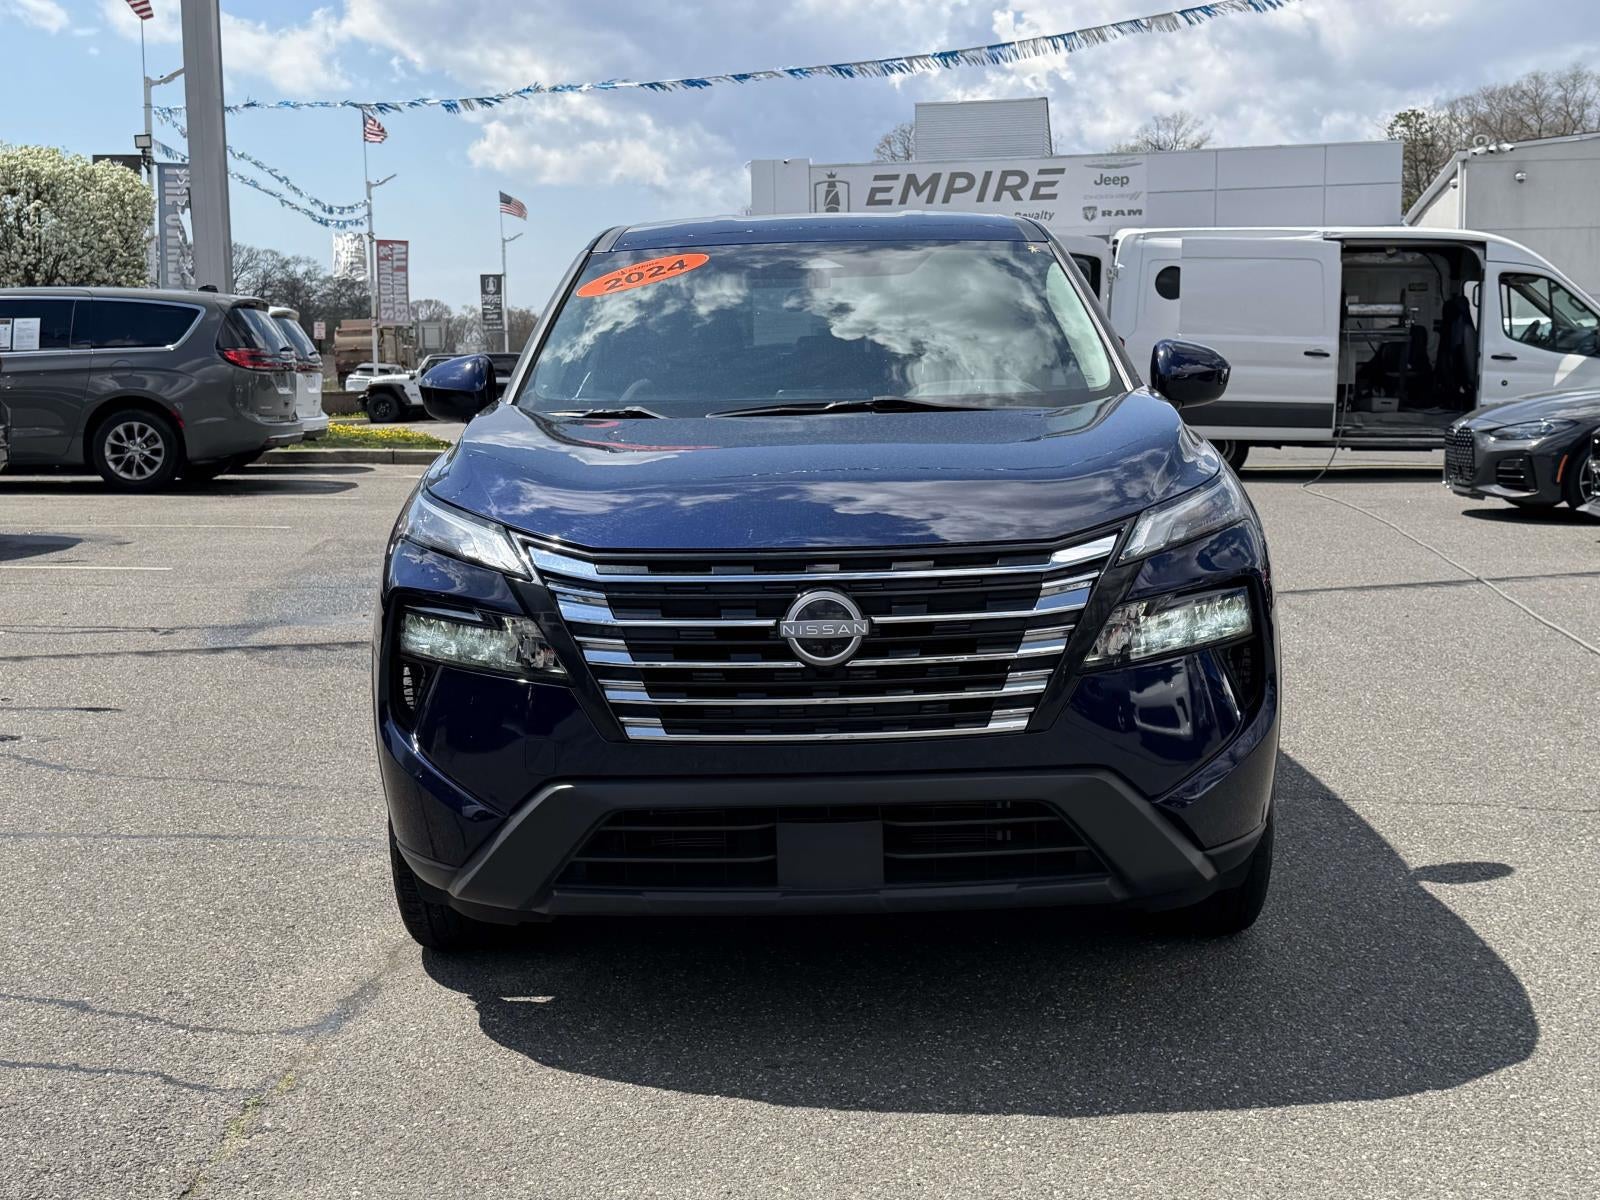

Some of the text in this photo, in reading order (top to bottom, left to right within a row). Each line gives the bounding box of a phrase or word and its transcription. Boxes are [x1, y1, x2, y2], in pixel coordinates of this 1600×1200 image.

[866, 168, 1066, 206] EMPIRE
[1094, 173, 1130, 187] Jeep
[1101, 209, 1143, 217] RAM
[379, 261, 394, 320] MODELS
[393, 243, 409, 321] ALL MAKES
[604, 259, 688, 291] 2024
[782, 624, 867, 635] NISSAN
